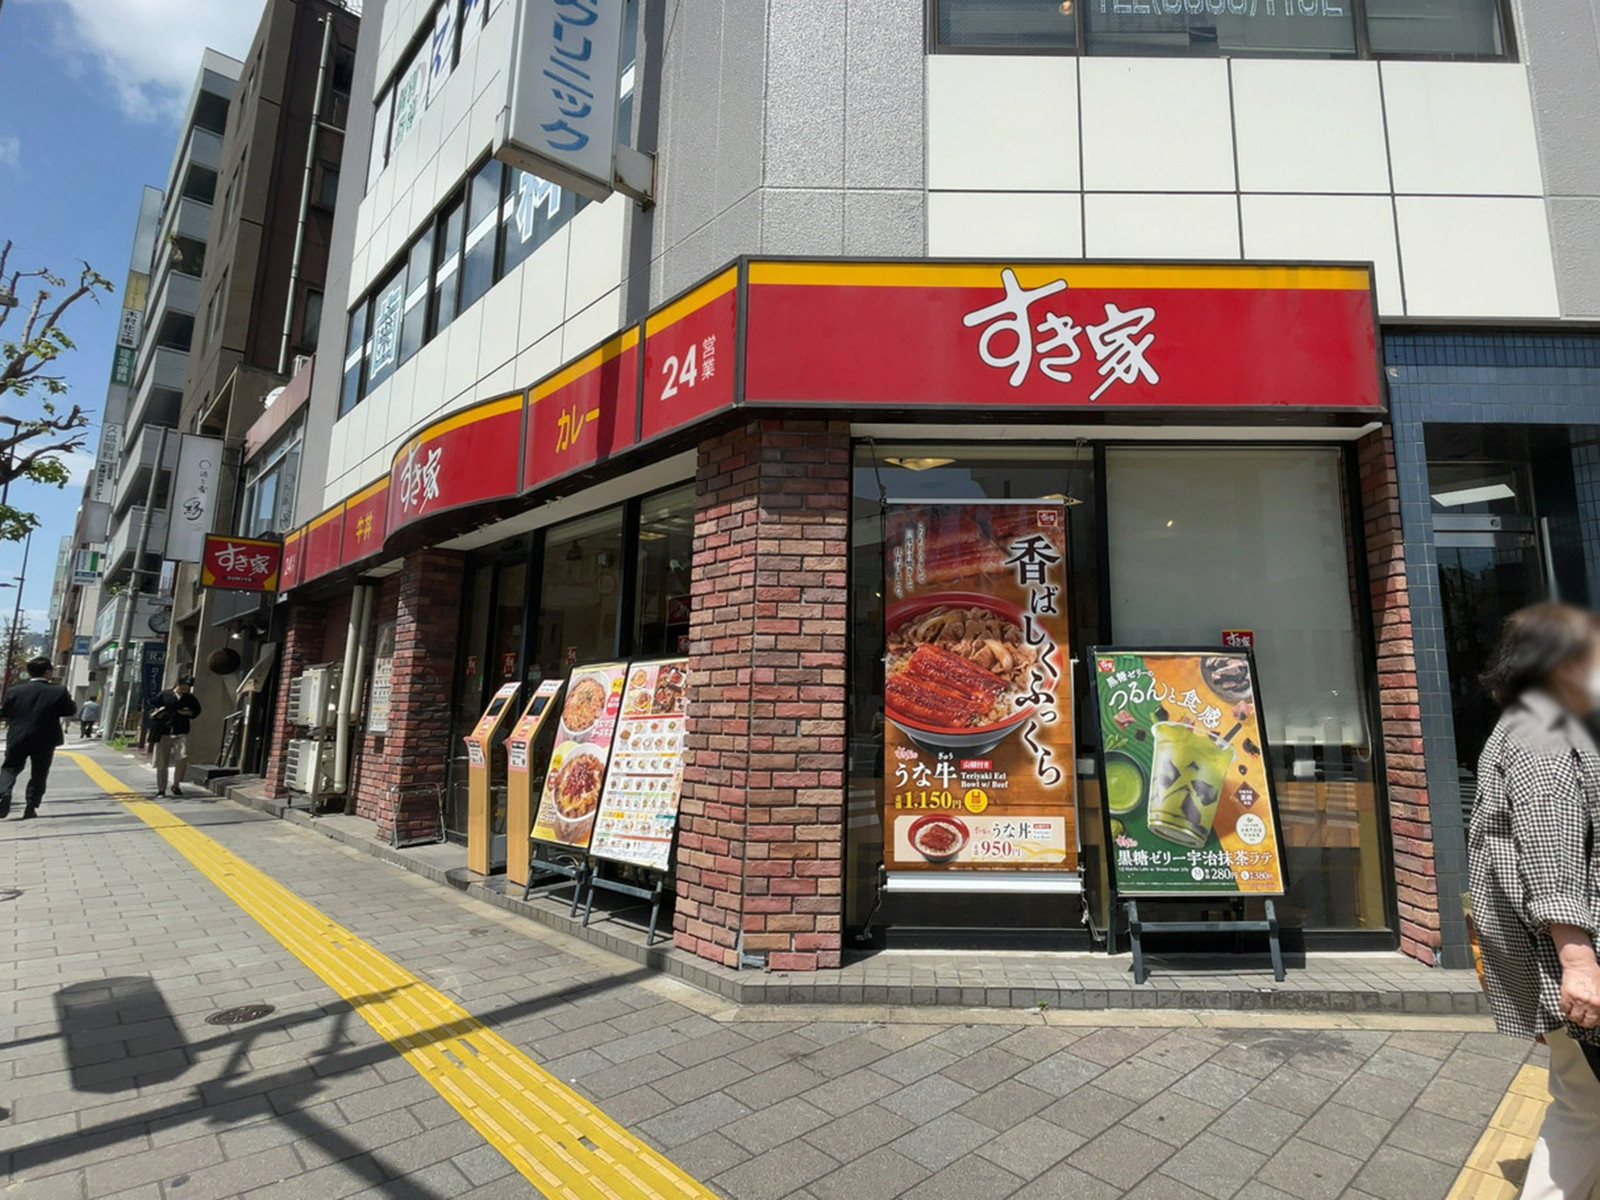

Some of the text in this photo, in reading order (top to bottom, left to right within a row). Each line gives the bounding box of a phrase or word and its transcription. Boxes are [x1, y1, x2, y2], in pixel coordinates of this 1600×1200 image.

[701, 334, 716, 381] 営業
[962, 267, 1160, 401] すき家
[660, 344, 697, 400] 24
[555, 404, 600, 453] カレー
[400, 441, 441, 514] すき家
[355, 510, 374, 544] 牛丼
[214, 542, 270, 577] すき家
[1005, 535, 1061, 785] 香ばしくふっくら
[1109, 677, 1222, 728] つるんと食感
[895, 761, 957, 789] うな牛
[960, 772, 1006, 782] Teriyaki Eel
[993, 822, 1032, 839] うな丼
[1117, 850, 1273, 866] 黒糖ゼリー宇治抹茶ラテ
